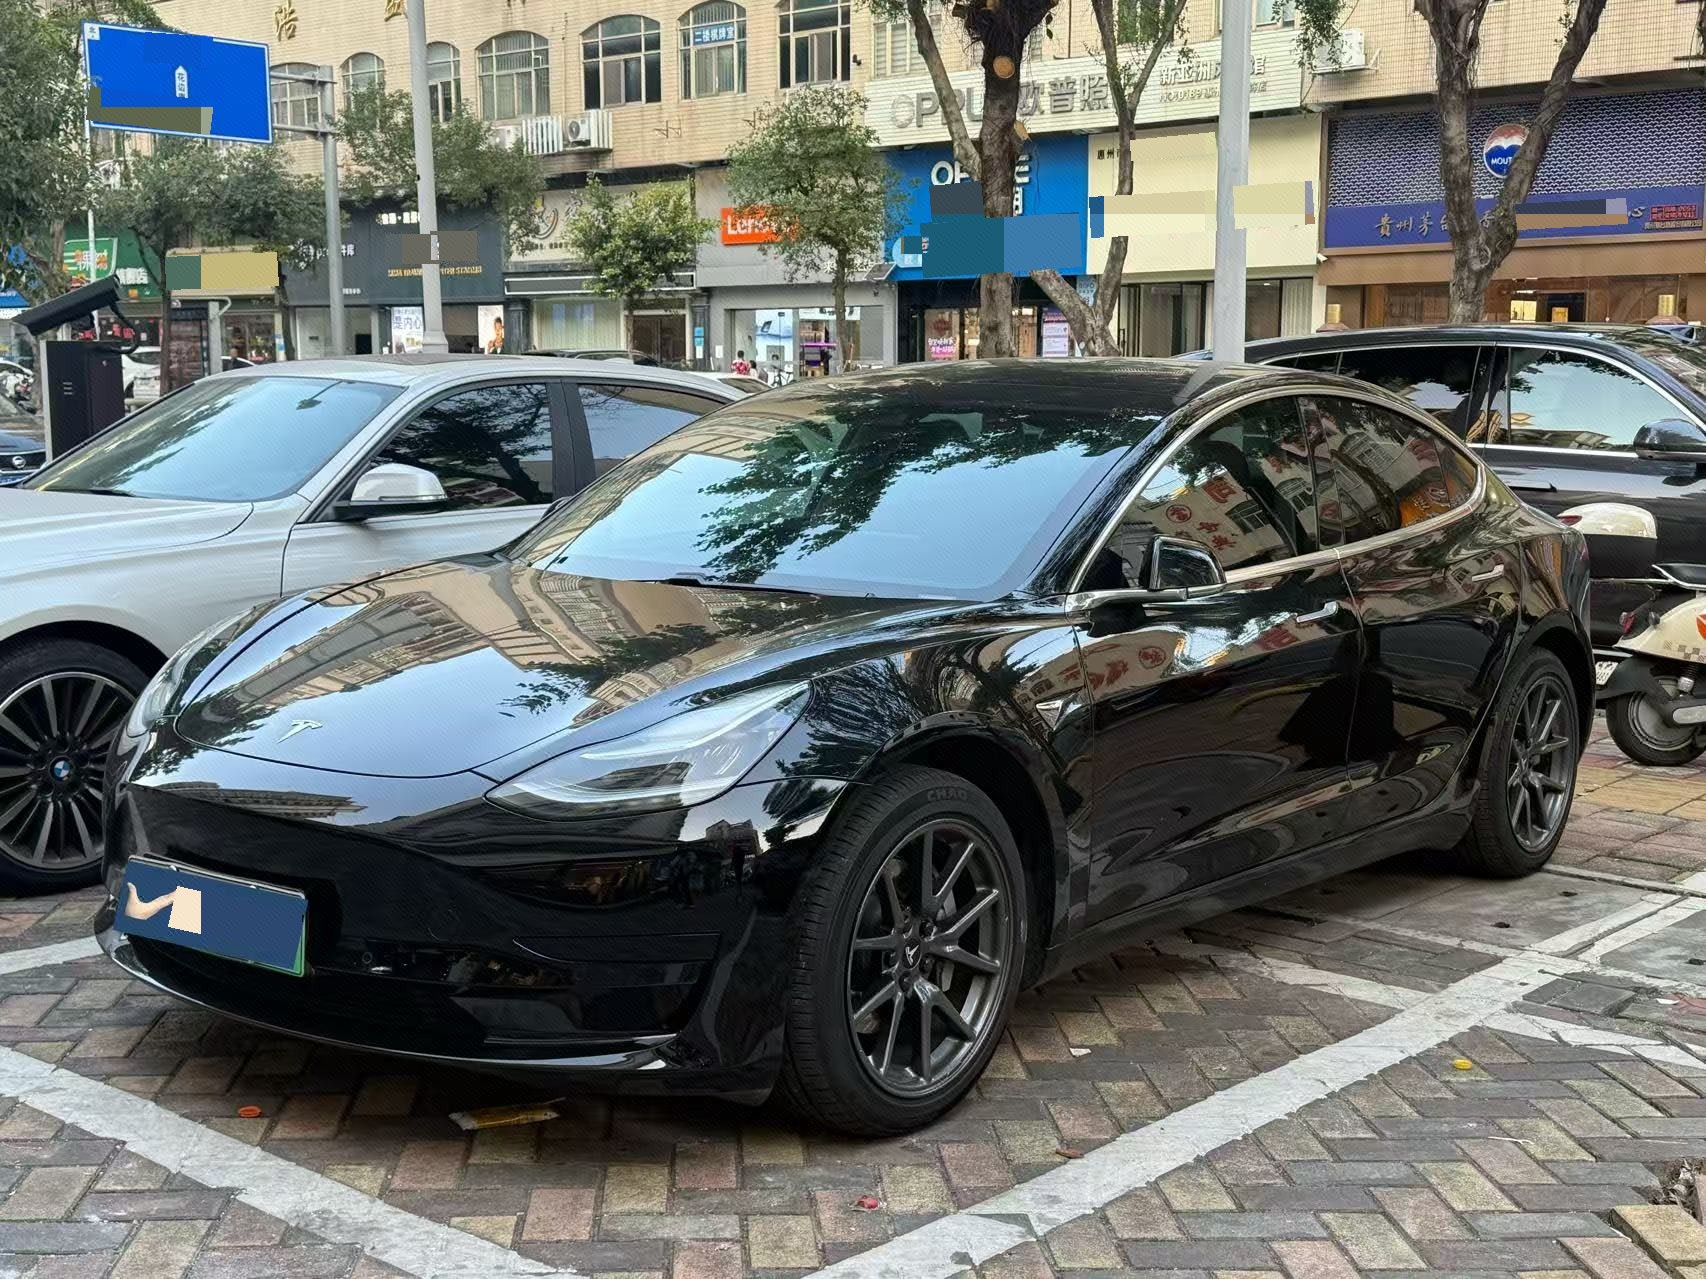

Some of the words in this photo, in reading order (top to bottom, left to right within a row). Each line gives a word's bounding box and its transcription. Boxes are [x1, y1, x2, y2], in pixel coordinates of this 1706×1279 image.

[1018, 74, 1110, 117] 欧普照
[1491, 157, 1513, 166] MOUT
